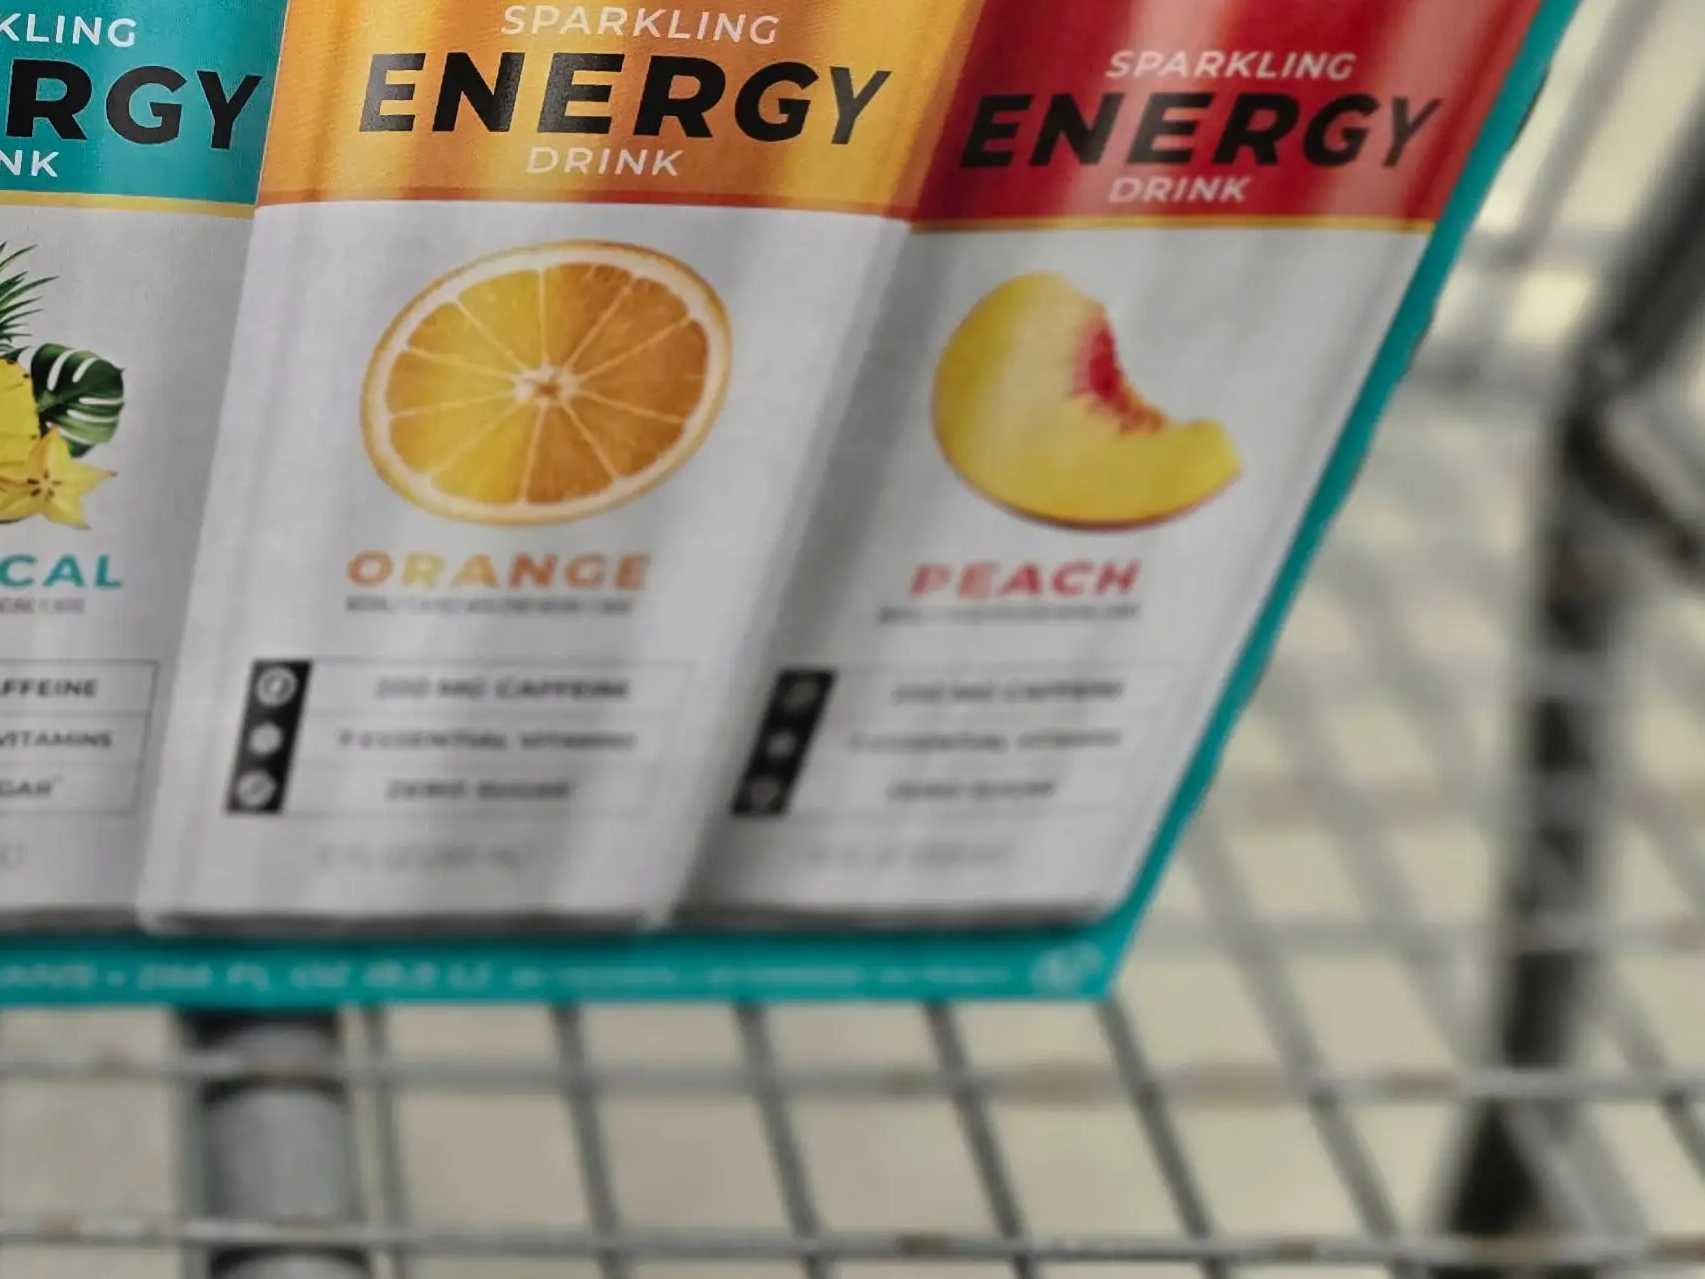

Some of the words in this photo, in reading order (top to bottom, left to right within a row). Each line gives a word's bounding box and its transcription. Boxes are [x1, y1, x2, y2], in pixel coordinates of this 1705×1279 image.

[501, 5, 780, 44] SPARKLING
[1106, 50, 1357, 81] SPARKLING
[358, 51, 892, 146] ENERGY
[959, 91, 1445, 171] ENERGY
[525, 145, 685, 177] DRINK
[1108, 175, 1252, 204] DRINK
[346, 550, 653, 591] ORANGE
[909, 559, 1142, 599] PEACH
